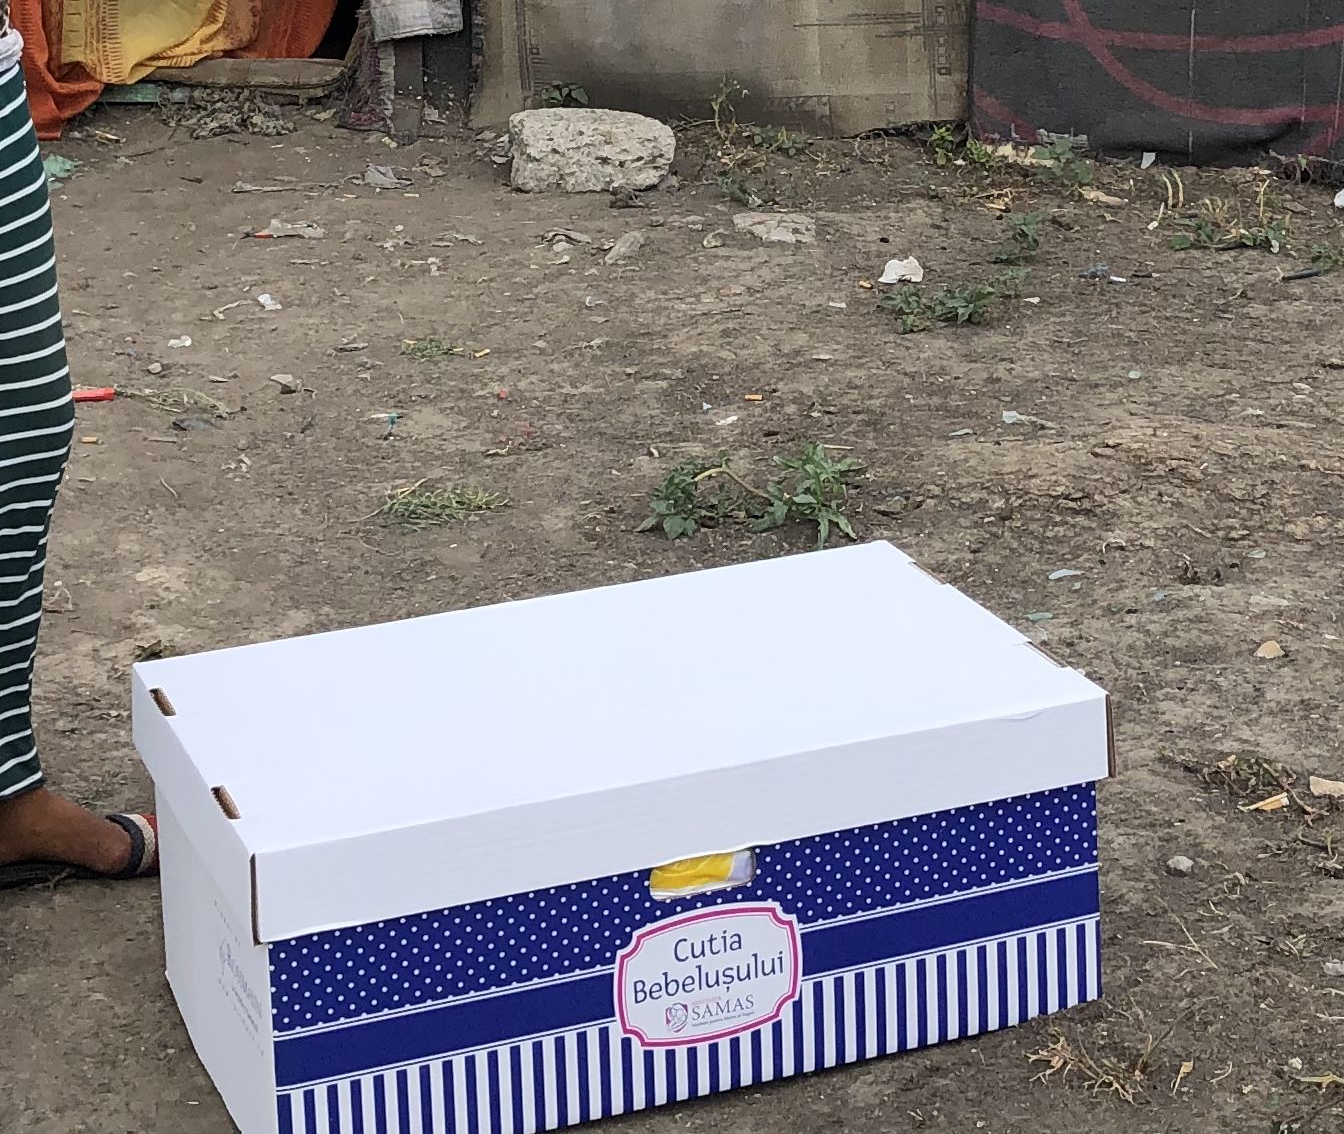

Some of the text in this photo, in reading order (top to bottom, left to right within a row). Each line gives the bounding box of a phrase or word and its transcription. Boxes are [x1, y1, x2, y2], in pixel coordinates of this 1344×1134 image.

[673, 929, 743, 963] Cutia
[632, 950, 784, 1005] Bebelușului
[691, 994, 754, 1021] SAMAS
